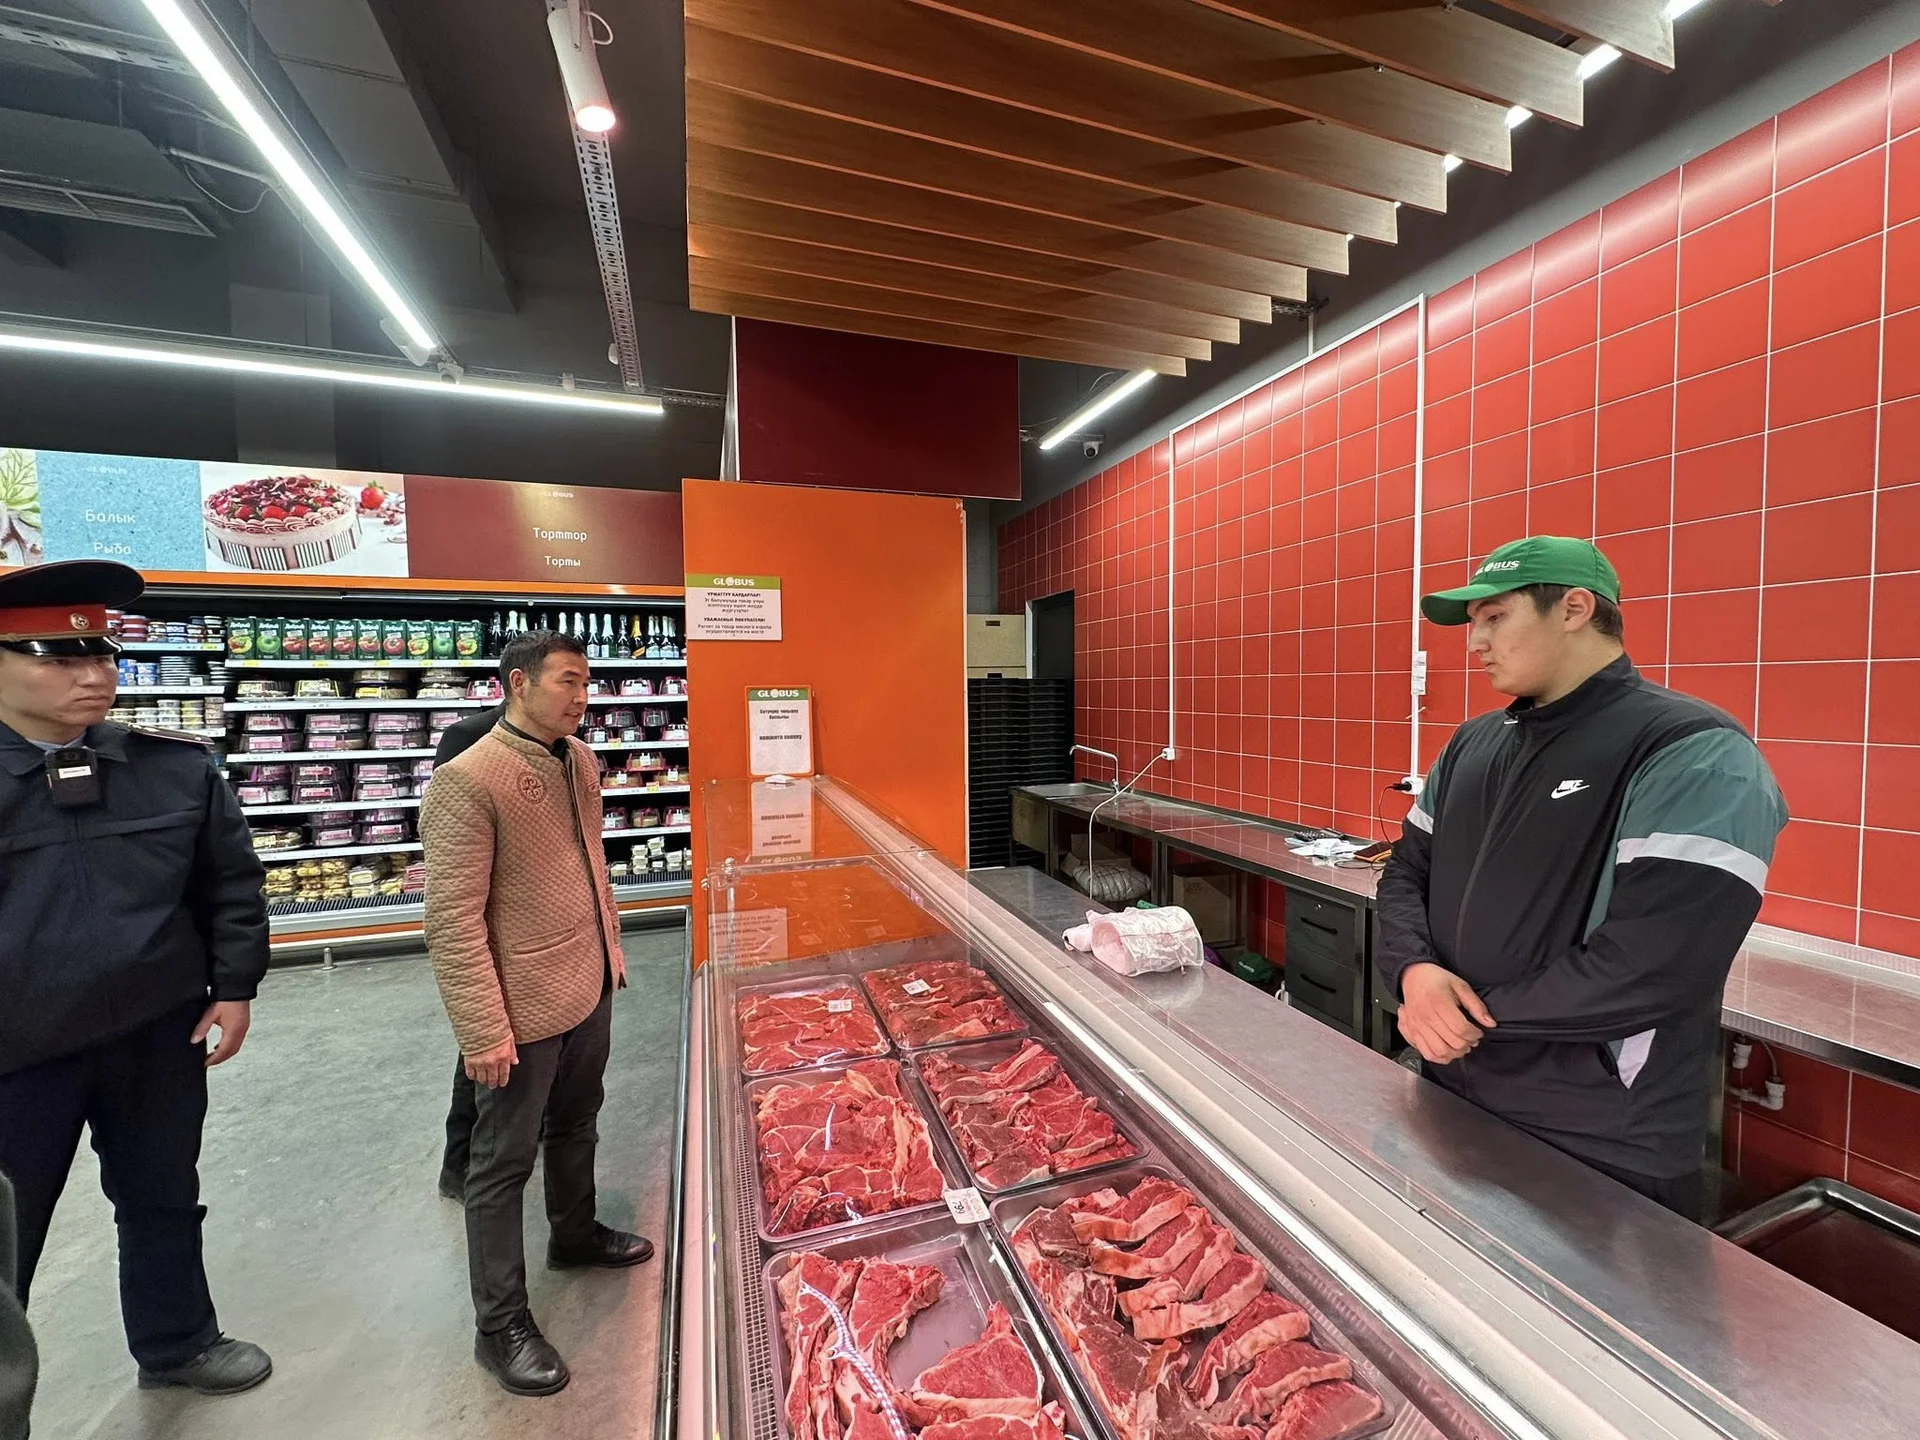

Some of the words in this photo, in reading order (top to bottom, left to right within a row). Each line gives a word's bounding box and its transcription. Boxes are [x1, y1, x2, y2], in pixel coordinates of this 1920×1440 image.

[85, 509, 136, 524] Балык
[532, 527, 588, 543] Торттор
[93, 541, 132, 555] Рыба
[544, 555, 581, 568] Торты
[713, 576, 755, 586] GLOBUS
[757, 689, 799, 698] GLOBUS
